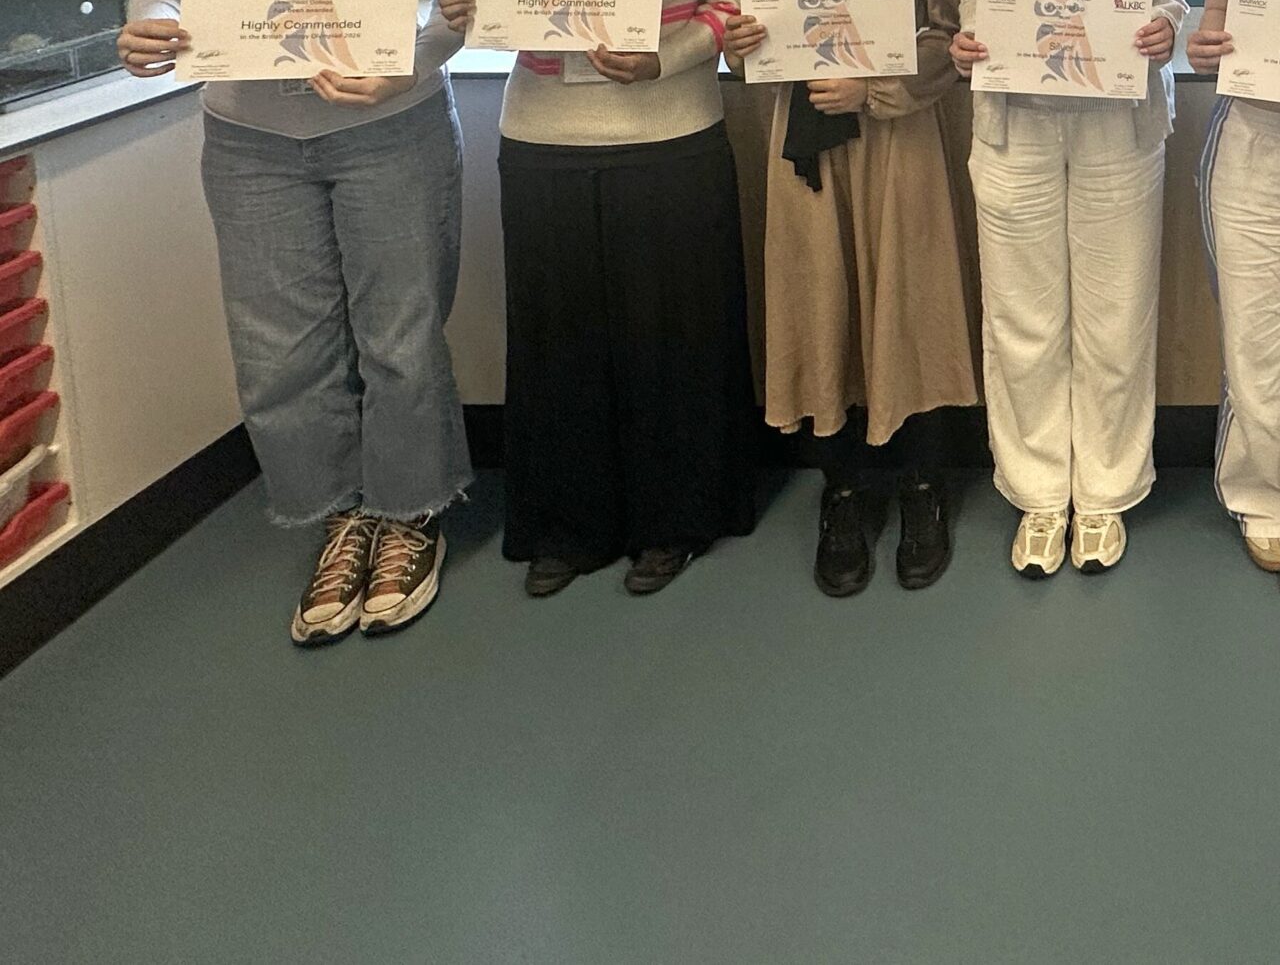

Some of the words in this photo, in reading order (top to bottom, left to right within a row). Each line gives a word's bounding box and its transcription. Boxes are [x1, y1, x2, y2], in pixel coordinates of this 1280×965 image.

[241, 20, 280, 32] Highly
[283, 20, 362, 30] Commended
[1049, 41, 1074, 51] Silver
